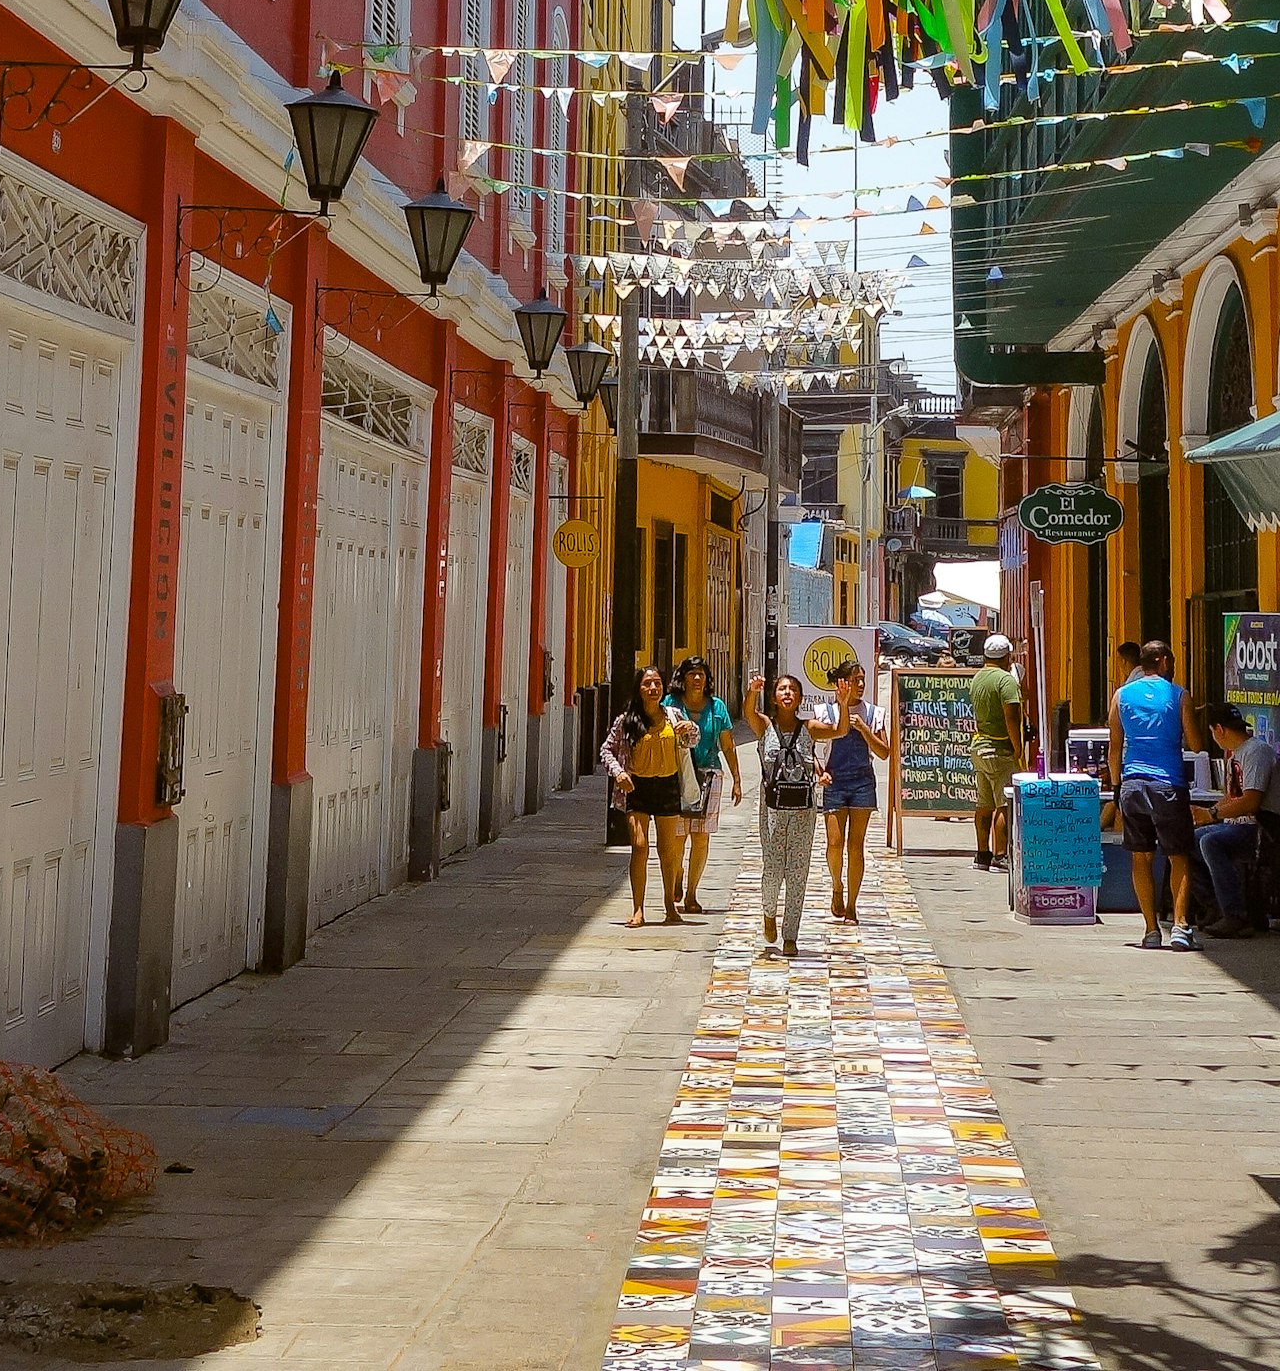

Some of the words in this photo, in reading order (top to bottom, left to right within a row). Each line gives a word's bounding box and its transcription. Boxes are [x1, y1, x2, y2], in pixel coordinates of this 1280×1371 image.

[1060, 496, 1076, 511] El
[1029, 506, 1112, 528] Comedor
[1045, 529, 1096, 537] Restaurante
[558, 531, 595, 553] ROLIS
[1236, 632, 1278, 671] boost
[904, 730, 930, 741] LOMO
[905, 741, 941, 755] PICANTE
[902, 755, 940, 768] CHAUFA
[1042, 894, 1076, 907] boost
